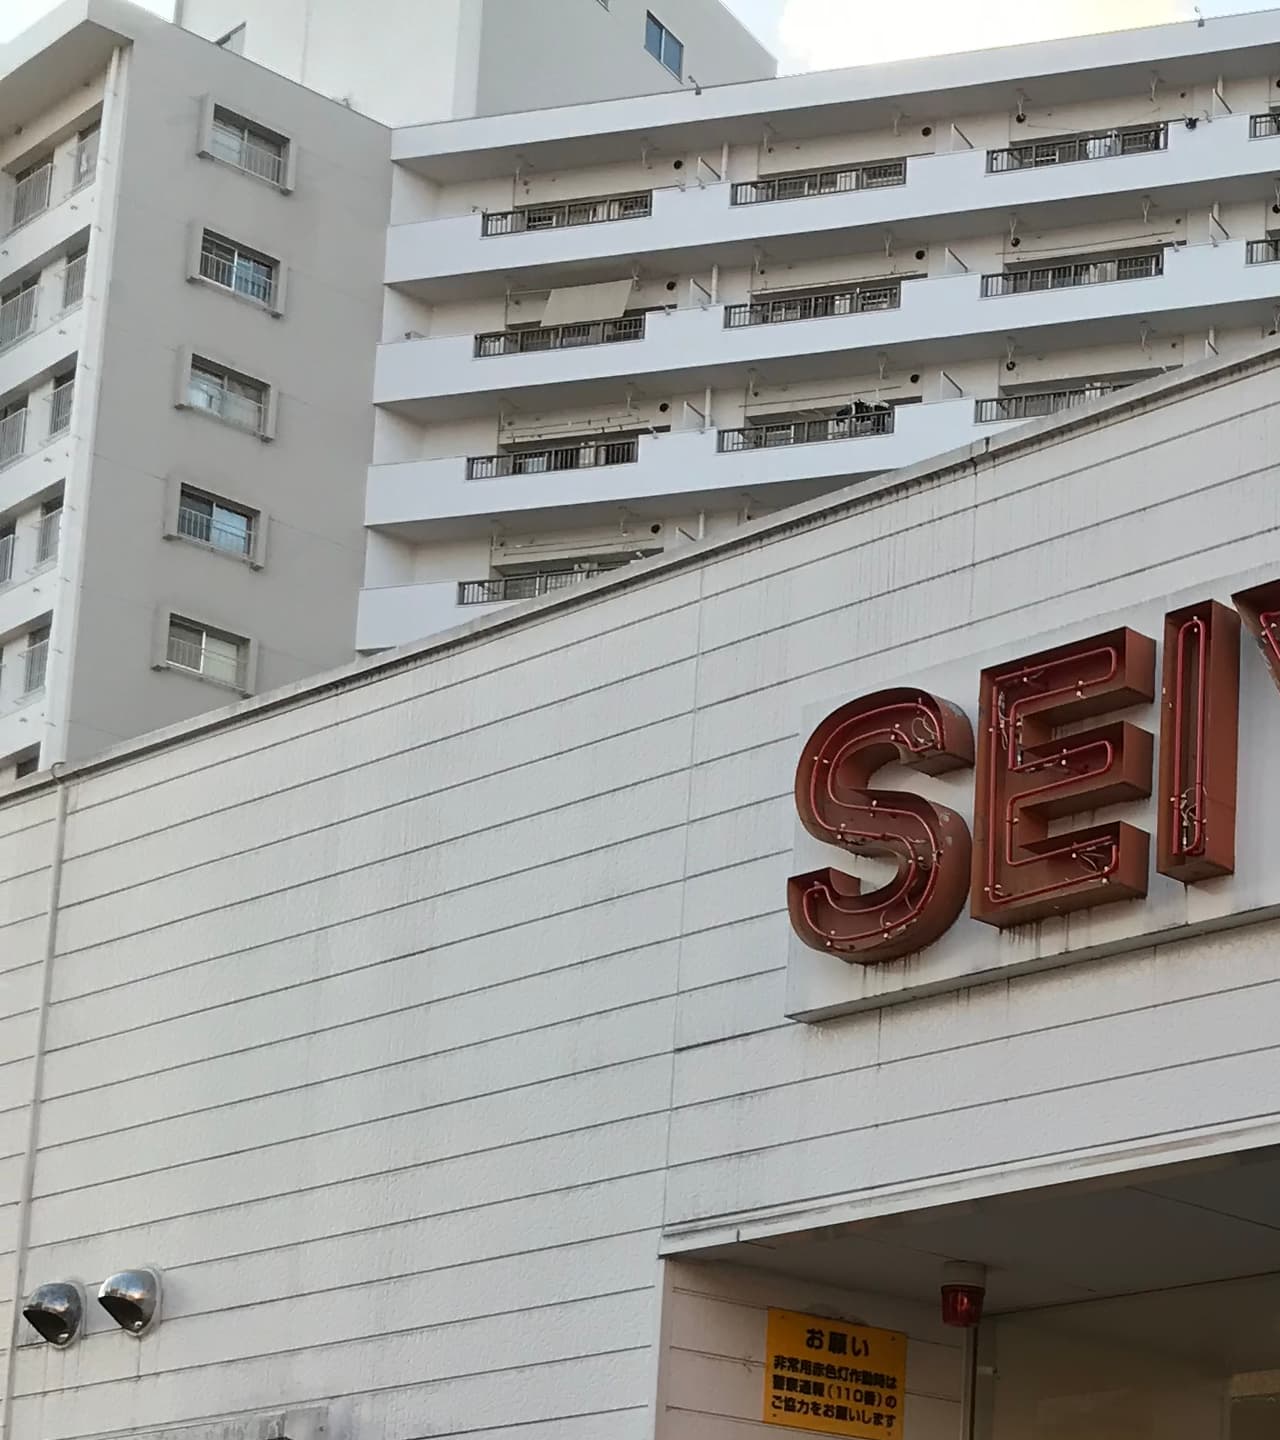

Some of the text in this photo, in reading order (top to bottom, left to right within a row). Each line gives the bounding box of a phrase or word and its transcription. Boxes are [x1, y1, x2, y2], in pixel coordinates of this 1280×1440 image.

[806, 1328, 869, 1357] お願い
[771, 1395, 896, 1428] ご協力をお願いします
